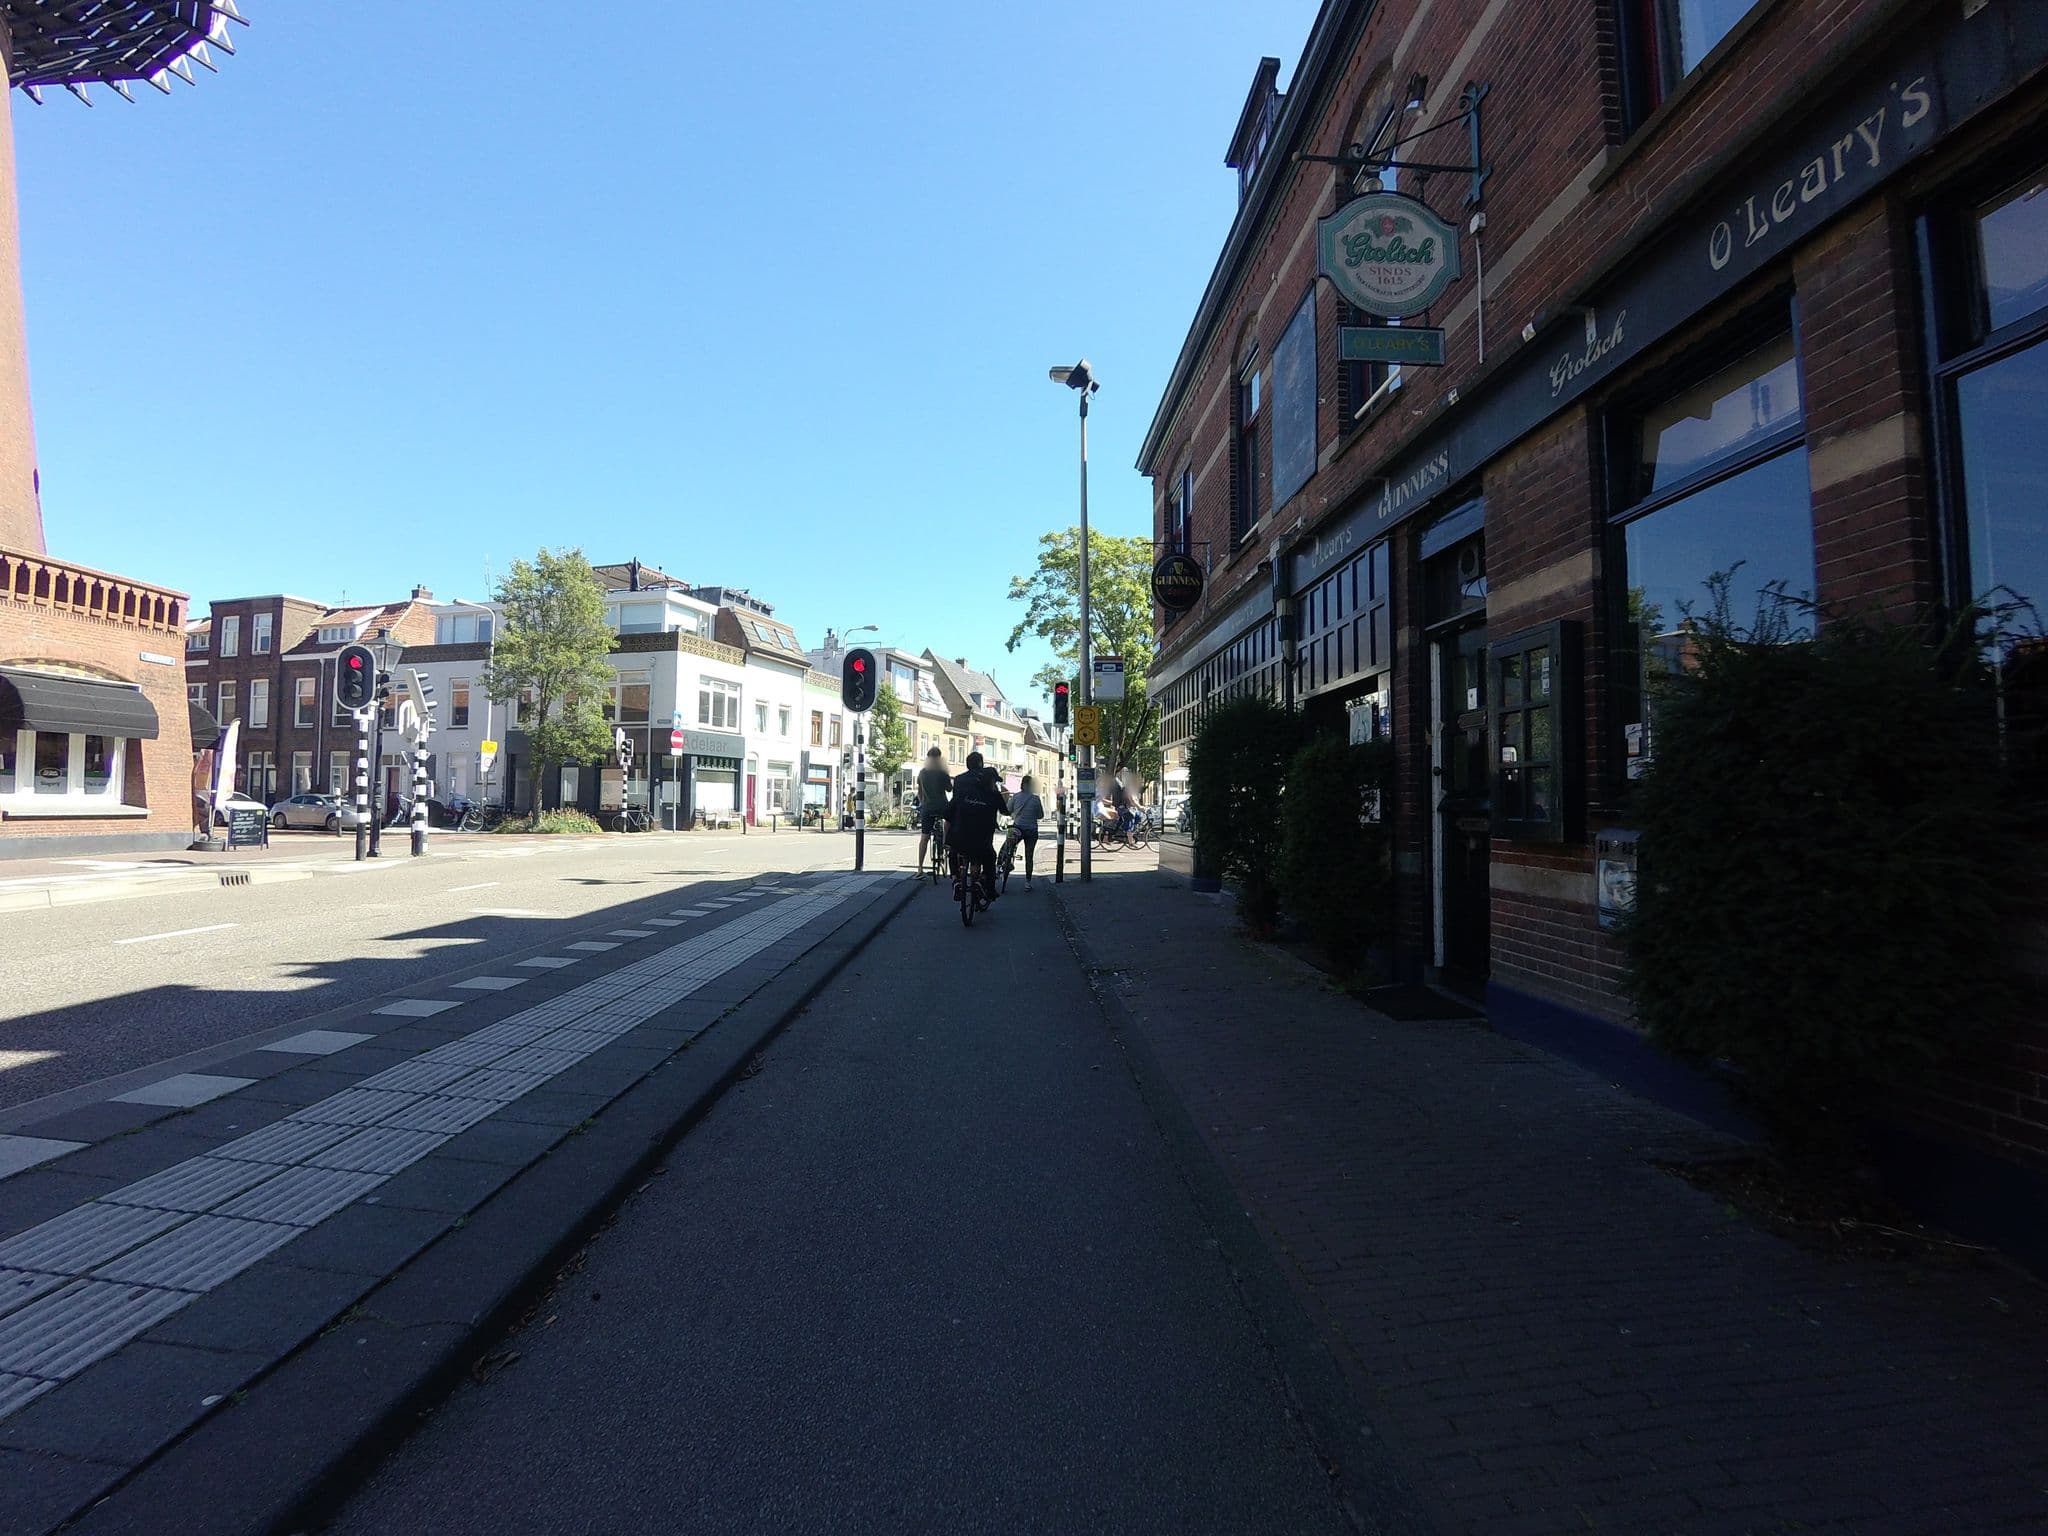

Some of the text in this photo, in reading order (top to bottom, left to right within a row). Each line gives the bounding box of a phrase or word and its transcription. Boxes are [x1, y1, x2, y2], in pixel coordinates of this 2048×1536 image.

[1709, 76, 1931, 271] O'Leary's
[1342, 232, 1434, 267] Grolsch
[1369, 266, 1412, 276] SINDS
[1378, 276, 1403, 285] 1615
[1550, 309, 1627, 398] Grolsch
[1378, 450, 1448, 519] GUINNESS
[1155, 575, 1201, 586] GUINNESS
